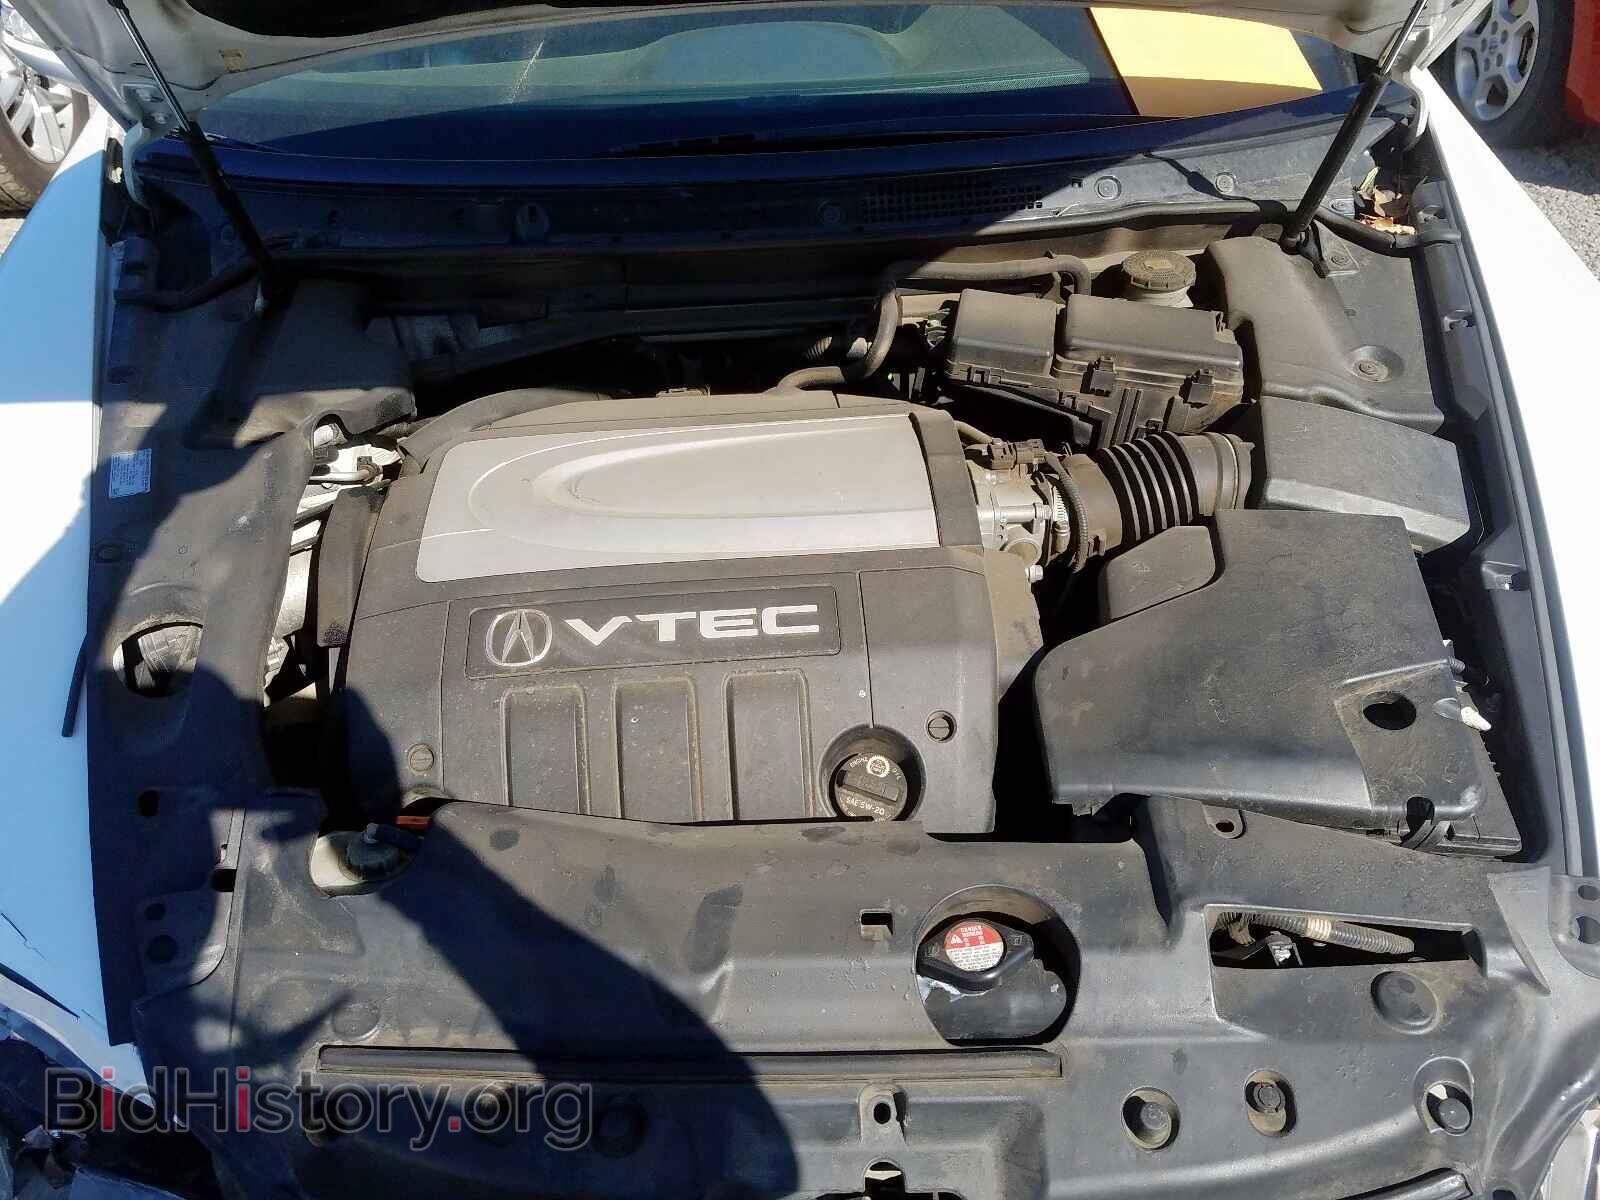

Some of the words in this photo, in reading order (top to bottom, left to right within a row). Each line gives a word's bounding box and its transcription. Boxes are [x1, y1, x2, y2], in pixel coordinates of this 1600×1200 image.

[565, 605, 819, 646] VTEC
[847, 796, 859, 807] SAE
[860, 801, 885, 815] 5W-20
